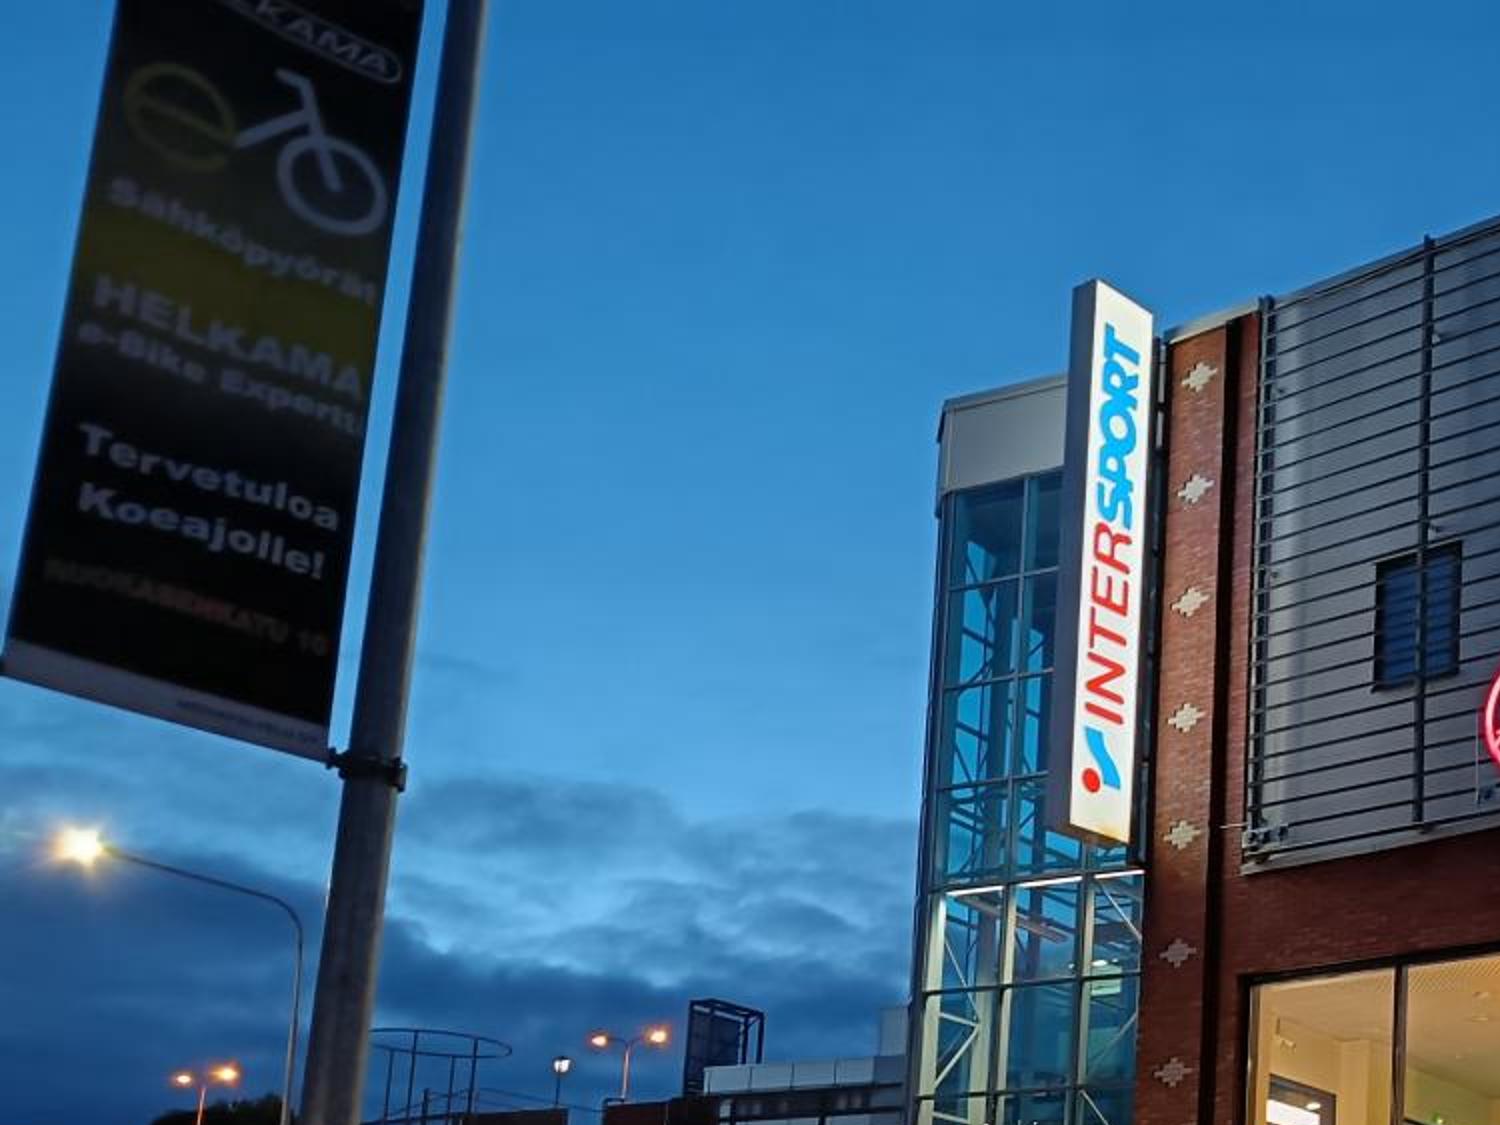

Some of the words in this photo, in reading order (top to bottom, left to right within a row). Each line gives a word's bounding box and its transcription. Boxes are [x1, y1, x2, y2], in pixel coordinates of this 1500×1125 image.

[94, 273, 362, 401] HELKAMA
[77, 421, 340, 532] Tervetuloa
[78, 481, 326, 581] Koeajolle!
[1085, 321, 1141, 725] INTERSPORT
